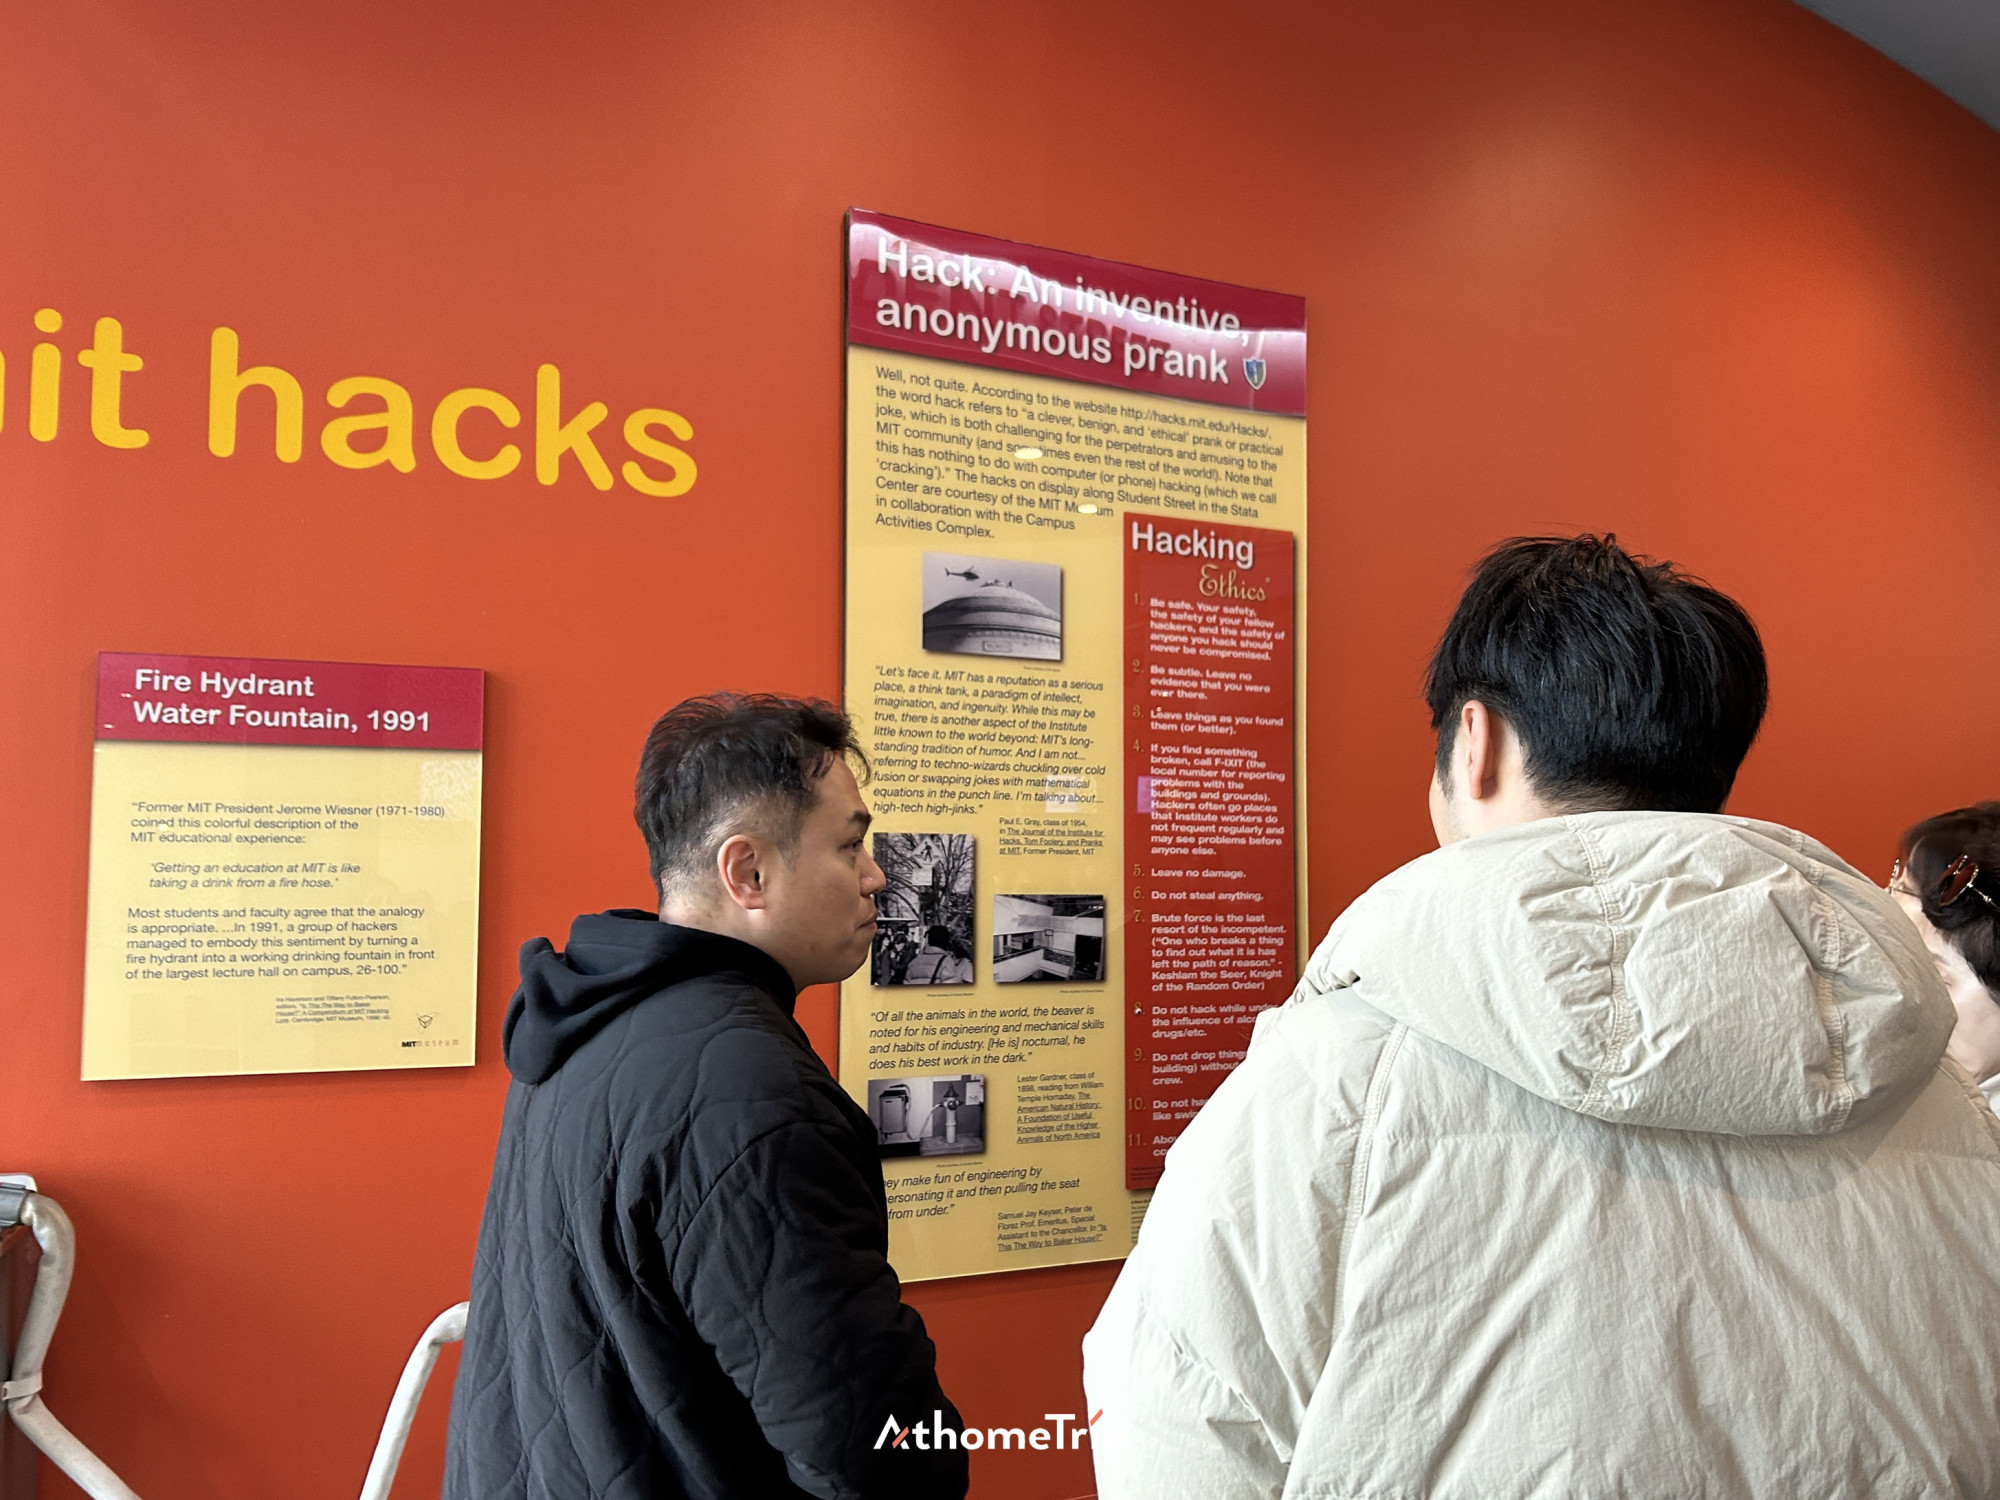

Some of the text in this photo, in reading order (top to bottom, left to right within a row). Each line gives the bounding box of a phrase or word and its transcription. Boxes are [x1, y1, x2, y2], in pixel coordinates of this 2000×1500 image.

[877, 236, 1250, 347] Hack: An inventive,
[876, 298, 1229, 385] anonymous prank
[875, 365, 906, 383] Well,
[909, 374, 931, 386] not
[933, 378, 968, 392] quite.
[970, 382, 1033, 405] According
[1036, 392, 1049, 405] to
[1051, 395, 1071, 408] the
[1072, 400, 1118, 415] website
[0, 307, 698, 498] it hacks
[875, 384, 896, 399] the
[899, 391, 931, 404] word
[934, 393, 965, 409] hack
[968, 401, 1003, 415] refers
[1005, 405, 1019, 418] to
[1037, 411, 1075, 427] clever,
[1077, 416, 1120, 434] benign,
[1122, 420, 1144, 436] and
[1192, 435, 1223, 447] prank
[1224, 440, 1236, 450] or
[1238, 442, 1283, 456] practical
[876, 494, 1075, 530] in collaboration with the Campus
[875, 513, 994, 538] Activities Complex.
[1132, 521, 1254, 570] Hacking
[135, 668, 315, 698] Fire Hydrant
[907, 667, 930, 679] face
[932, 669, 941, 680] it.
[944, 670, 965, 681] MIT
[966, 672, 984, 683] has
[986, 675, 993, 683] a
[995, 676, 1046, 686] reputation
[1047, 679, 1059, 688] as
[1061, 680, 1067, 688] a
[1070, 680, 1103, 691] serious
[133, 701, 430, 732] Water Fountain, 1991
[874, 696, 1096, 720] imagination, and ingenuity. While this may be
[1150, 708, 1182, 720] Leave
[1184, 712, 1217, 723] things
[1219, 715, 1232, 723] as
[1234, 716, 1253, 725] you
[1255, 715, 1283, 726] found
[187, 802, 212, 812] MIT
[214, 802, 273, 814] President
[276, 804, 322, 814] Jerome
[324, 804, 373, 815] Wiesner
[375, 805, 445, 817] (1971-1980)
[874, 801, 923, 814] high-tech
[177, 817, 201, 828] this
[204, 817, 250, 828] colorful
[253, 818, 321, 830] description
[324, 818, 337, 829] of
[339, 819, 359, 829] the
[130, 831, 305, 845] MIT educational experience:
[203, 864, 219, 873] an
[222, 862, 283, 873] education
[285, 863, 299, 873] at
[301, 862, 326, 872] MIT
[327, 862, 338, 873] is
[340, 863, 361, 873] like
[1150, 868, 1183, 877] Leave
[1185, 869, 1200, 877] no
[1201, 869, 1246, 879] damage.
[1151, 890, 1167, 899] Do
[1169, 891, 1187, 900] not
[1189, 891, 1215, 900] steal
[1218, 891, 1264, 901] anything.
[128, 906, 425, 919] Most students and faculty agree that the analogy
[1151, 913, 1181, 922] Brute
[1183, 913, 1212, 922] force
[1214, 913, 1224, 922] is
[1226, 913, 1243, 922] the
[1246, 913, 1265, 922] last
[124, 968, 138, 979] of
[142, 969, 163, 979] the
[166, 968, 209, 981] largest
[212, 968, 255, 977] lecture
[258, 966, 279, 976] hall
[282, 967, 298, 976] on
[301, 967, 353, 977] campus,
[890, 1010, 904, 1022] all
[906, 1010, 923, 1021] the
[925, 1009, 965, 1020] animals
[968, 1008, 978, 1018] in
[980, 1008, 997, 1018] the
[999, 1006, 1030, 1017] world,
[1032, 1006, 1049, 1016] the
[1050, 1006, 1085, 1016] beaver
[1086, 1005, 1094, 1015] is
[869, 1058, 896, 1070] does
[898, 1057, 915, 1068] his
[916, 1056, 941, 1067] best
[943, 1054, 969, 1065] work
[970, 1054, 981, 1064] in
[983, 1053, 1000, 1064] the
